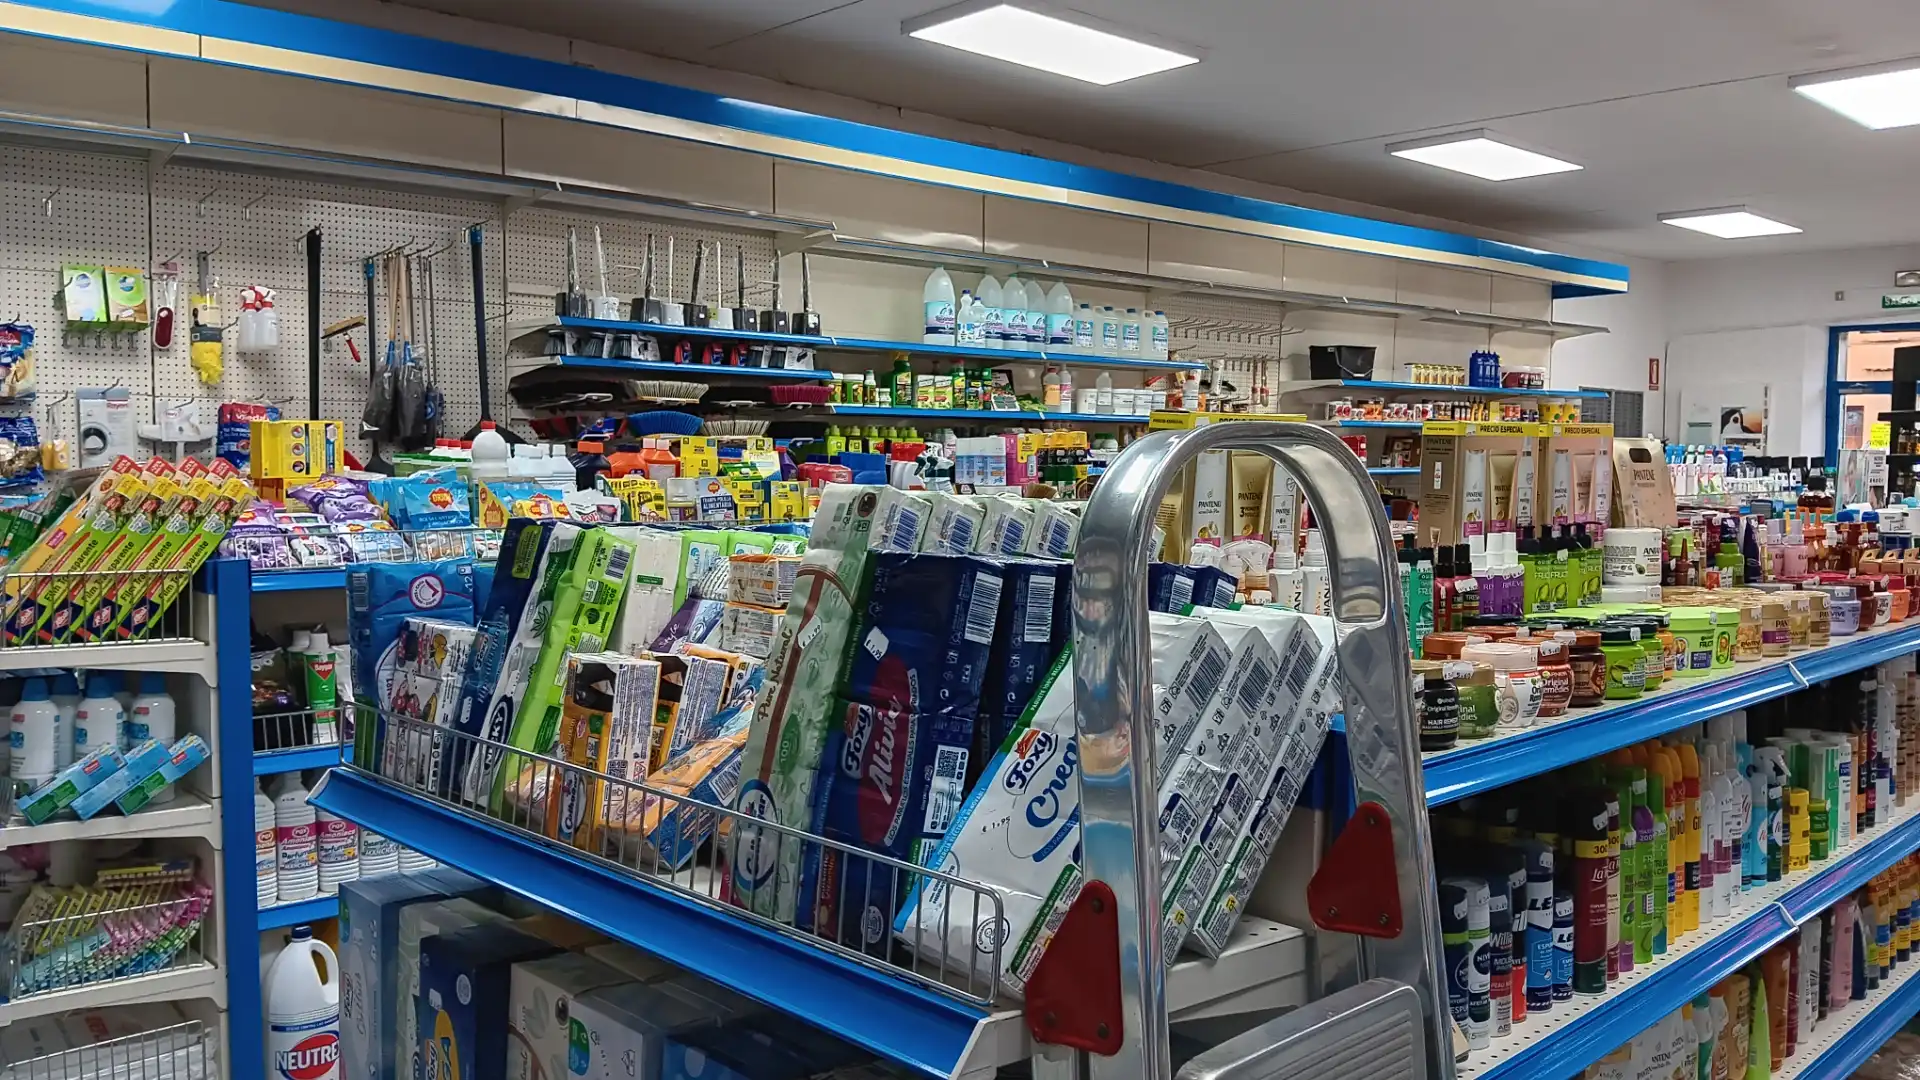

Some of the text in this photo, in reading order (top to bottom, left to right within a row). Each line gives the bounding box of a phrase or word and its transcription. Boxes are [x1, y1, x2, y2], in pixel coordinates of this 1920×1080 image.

[1479, 425, 1524, 434] PRECIO ESPECIAL
[56, 536, 98, 586] Trnsparente
[93, 538, 135, 588] Trasparente
[133, 538, 173, 586] Trasparente
[170, 538, 209, 585] Trasparente
[485, 713, 505, 766] NIKY
[1006, 732, 1052, 790] Foxy
